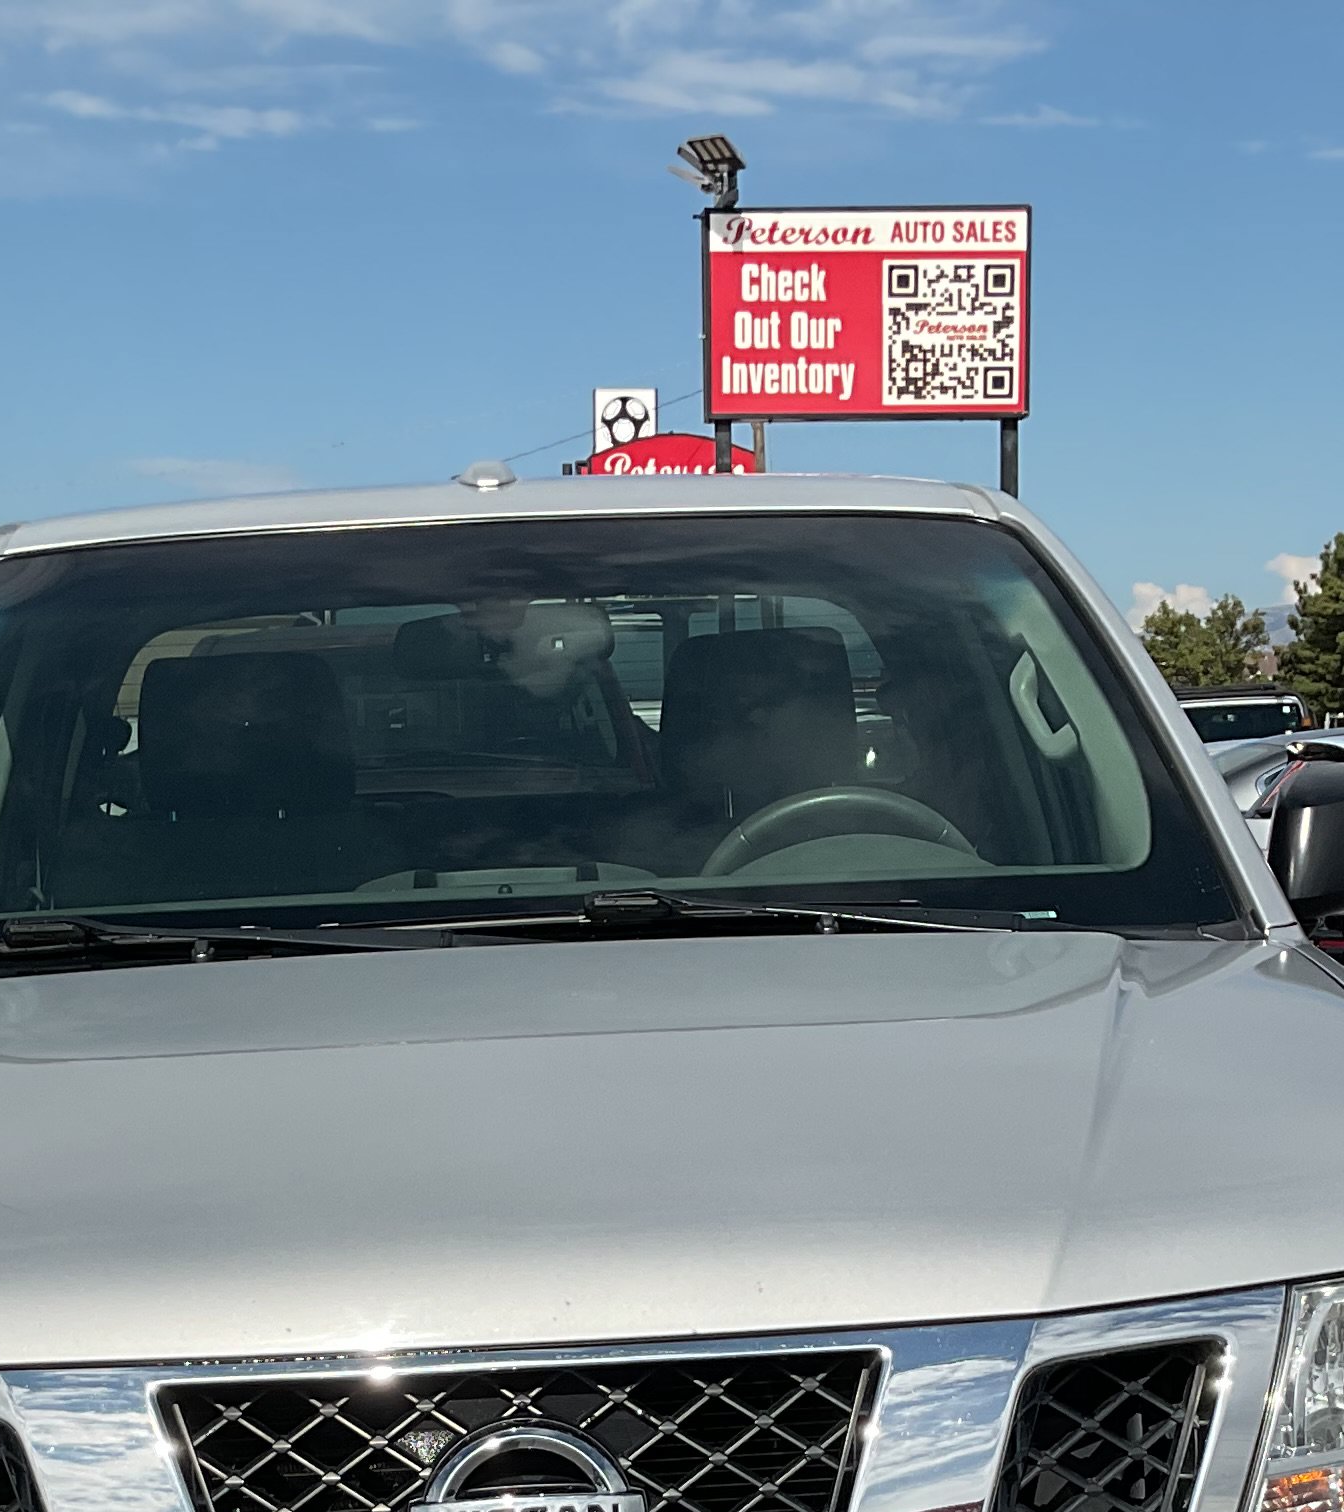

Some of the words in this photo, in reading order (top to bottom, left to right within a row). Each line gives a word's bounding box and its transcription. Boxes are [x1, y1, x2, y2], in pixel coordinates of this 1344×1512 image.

[723, 216, 875, 246] Peterson
[890, 221, 945, 244] AUTO
[952, 220, 1017, 243] SALES
[741, 263, 827, 302] Check
[734, 311, 781, 349] Out
[790, 311, 842, 349] Our
[913, 319, 988, 335] Peterson
[722, 356, 855, 401] Inventory
